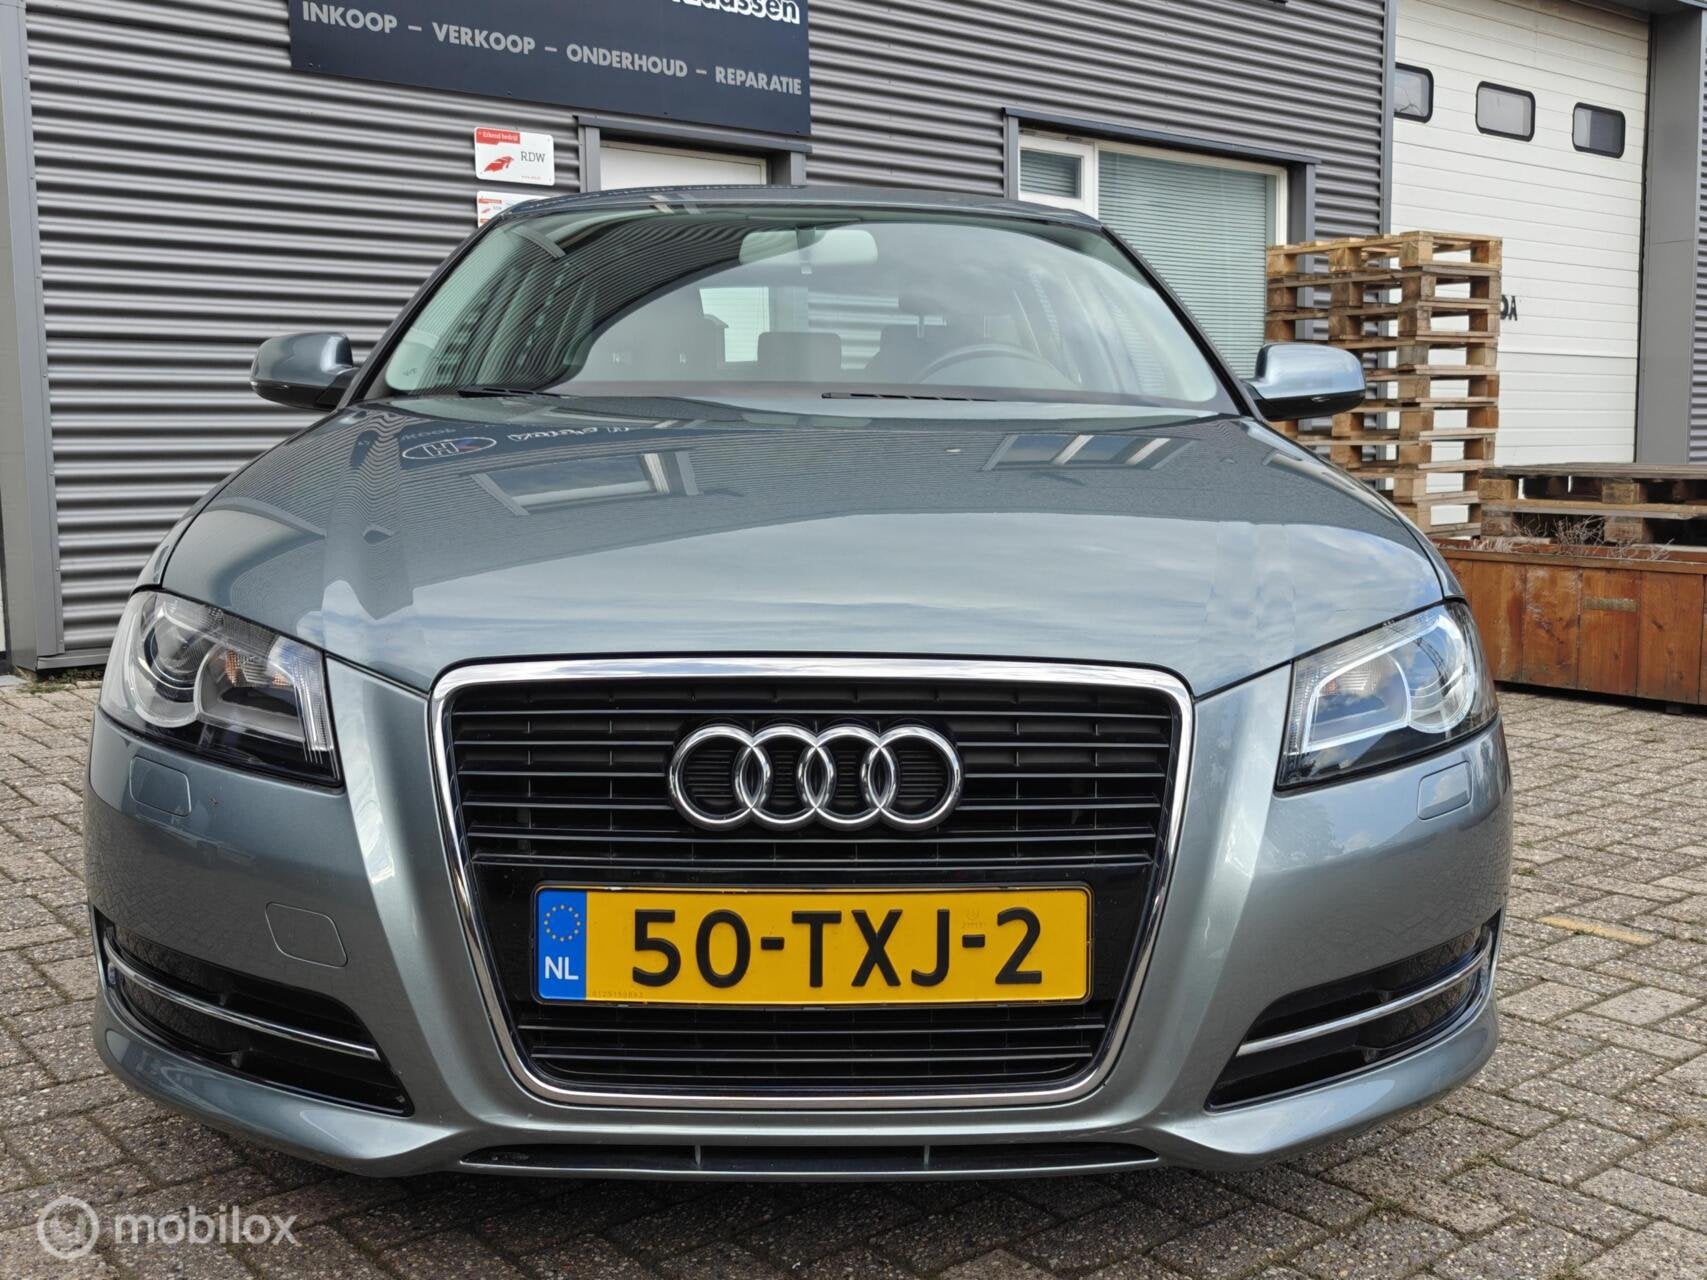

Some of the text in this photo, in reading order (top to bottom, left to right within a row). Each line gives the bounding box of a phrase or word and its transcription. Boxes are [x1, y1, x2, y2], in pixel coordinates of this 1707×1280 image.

[672, 0, 800, 24] assen
[302, 0, 398, 35] INKOOP
[431, 21, 537, 56] VERKOOP
[566, 43, 688, 78] ONDERHOUD
[715, 65, 802, 95] REPARATIE
[520, 151, 546, 163] RDW
[632, 906, 1043, 989] 50-TXJ-2
[544, 956, 579, 980] NL
